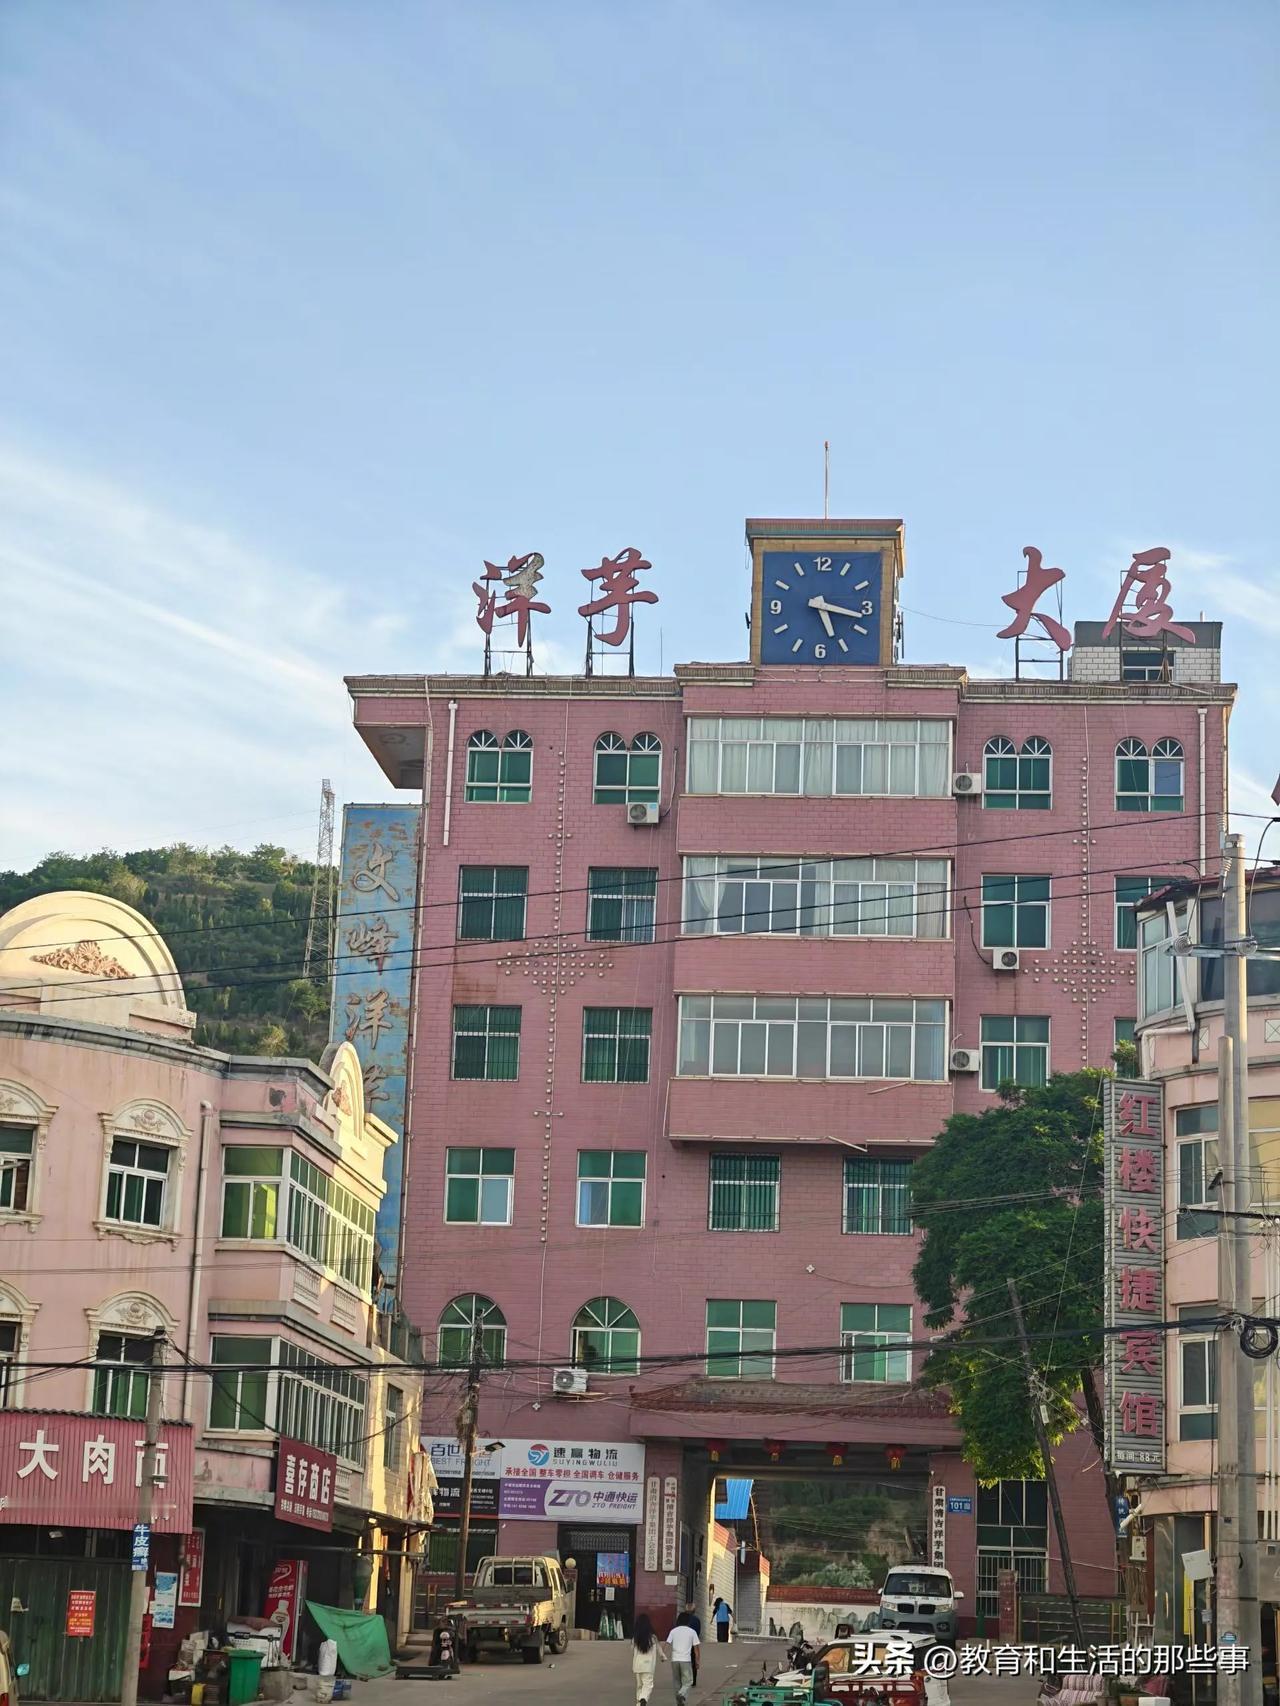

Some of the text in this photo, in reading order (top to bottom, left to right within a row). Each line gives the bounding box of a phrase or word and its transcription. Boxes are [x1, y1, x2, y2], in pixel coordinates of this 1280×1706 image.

[812, 556, 832, 571] 12
[770, 601, 782, 614] 9
[860, 601, 873, 615] 3
[814, 643, 826, 658] 6
[1117, 1090, 1159, 1437] 红楼快捷宾馆
[553, 1447, 618, 1460] 速赢物流
[548, 1489, 592, 1508] ZTO
[592, 1491, 638, 1504] 中通快运
